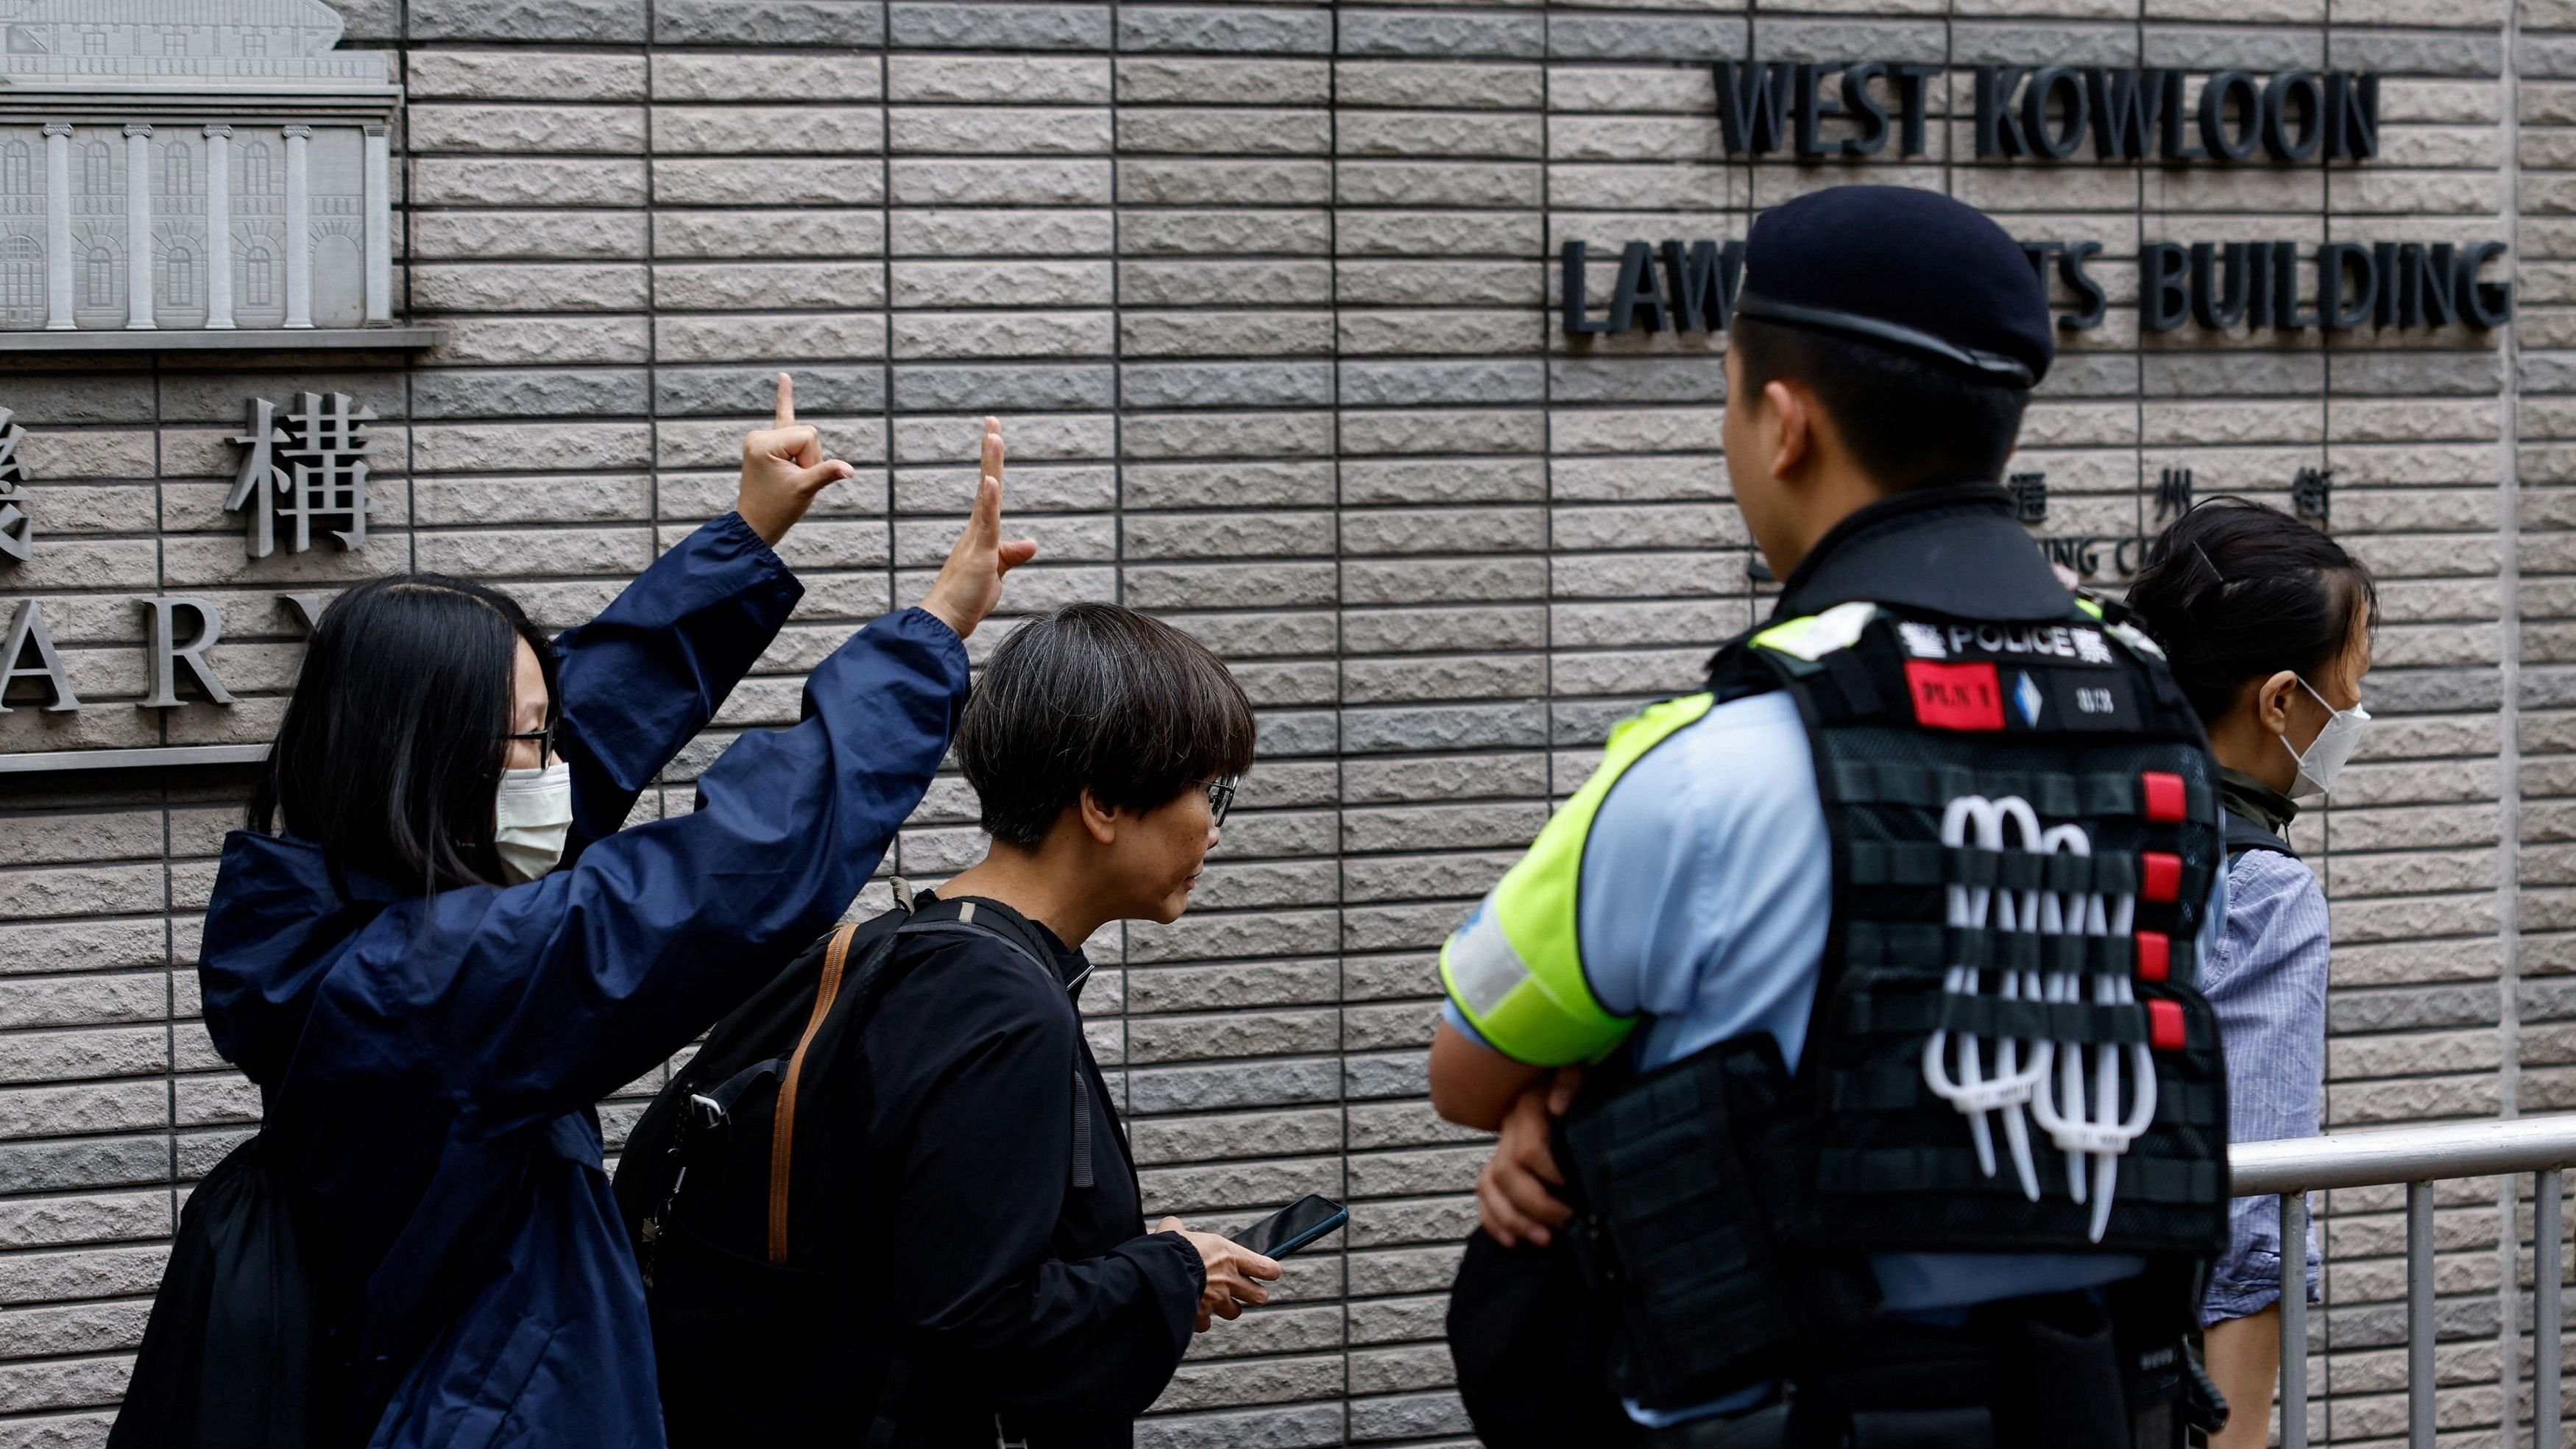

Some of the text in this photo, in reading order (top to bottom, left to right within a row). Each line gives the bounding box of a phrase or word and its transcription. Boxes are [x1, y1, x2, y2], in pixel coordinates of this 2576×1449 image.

[1712, 61, 2379, 161] WEST KOWLOON
[1562, 241, 1747, 333] LAW
[2139, 241, 2511, 334] BUILDING
[0, 594, 324, 714] AR
[1949, 624, 2076, 657] POLICE
